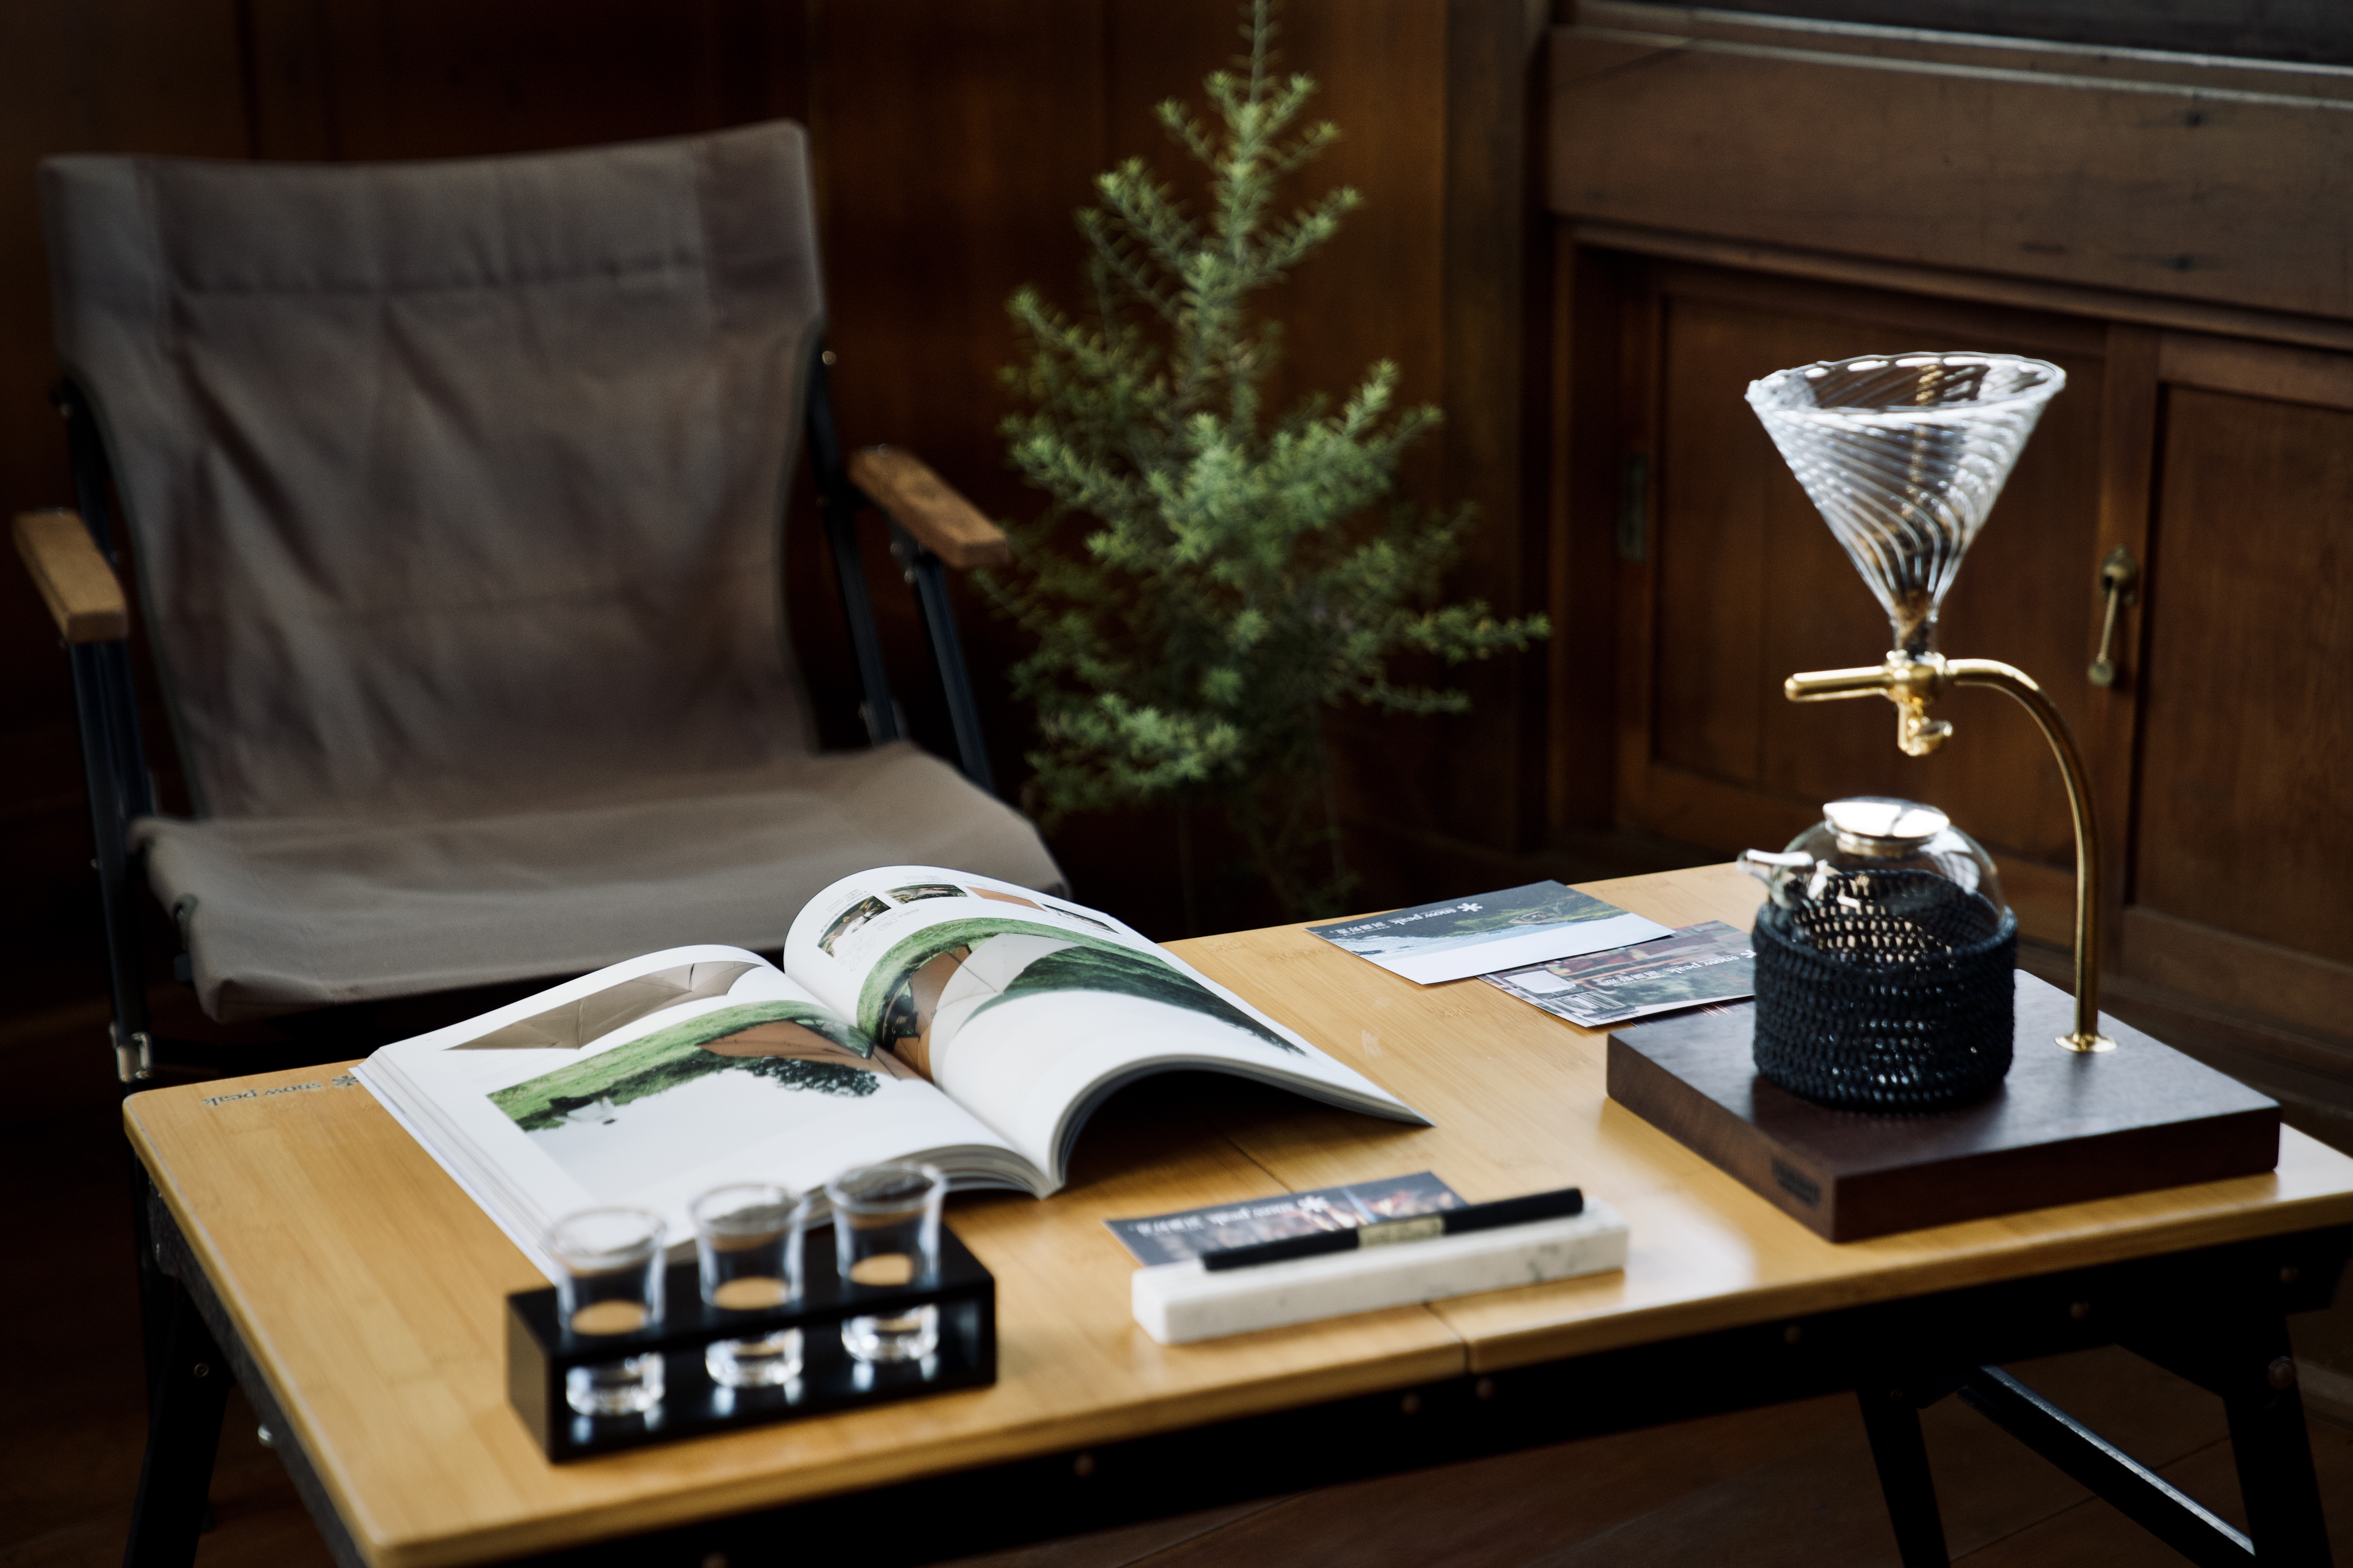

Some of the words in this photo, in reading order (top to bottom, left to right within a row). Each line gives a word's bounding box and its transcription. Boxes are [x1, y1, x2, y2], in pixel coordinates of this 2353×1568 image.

[898, 909, 920, 918] SHIELD
[1424, 907, 1457, 918] snow
[1390, 913, 1423, 925] peak
[1704, 955, 1740, 966] snow
[1665, 962, 1703, 974] peak
[264, 1082, 322, 1095] snow
[202, 1089, 257, 1106] peak
